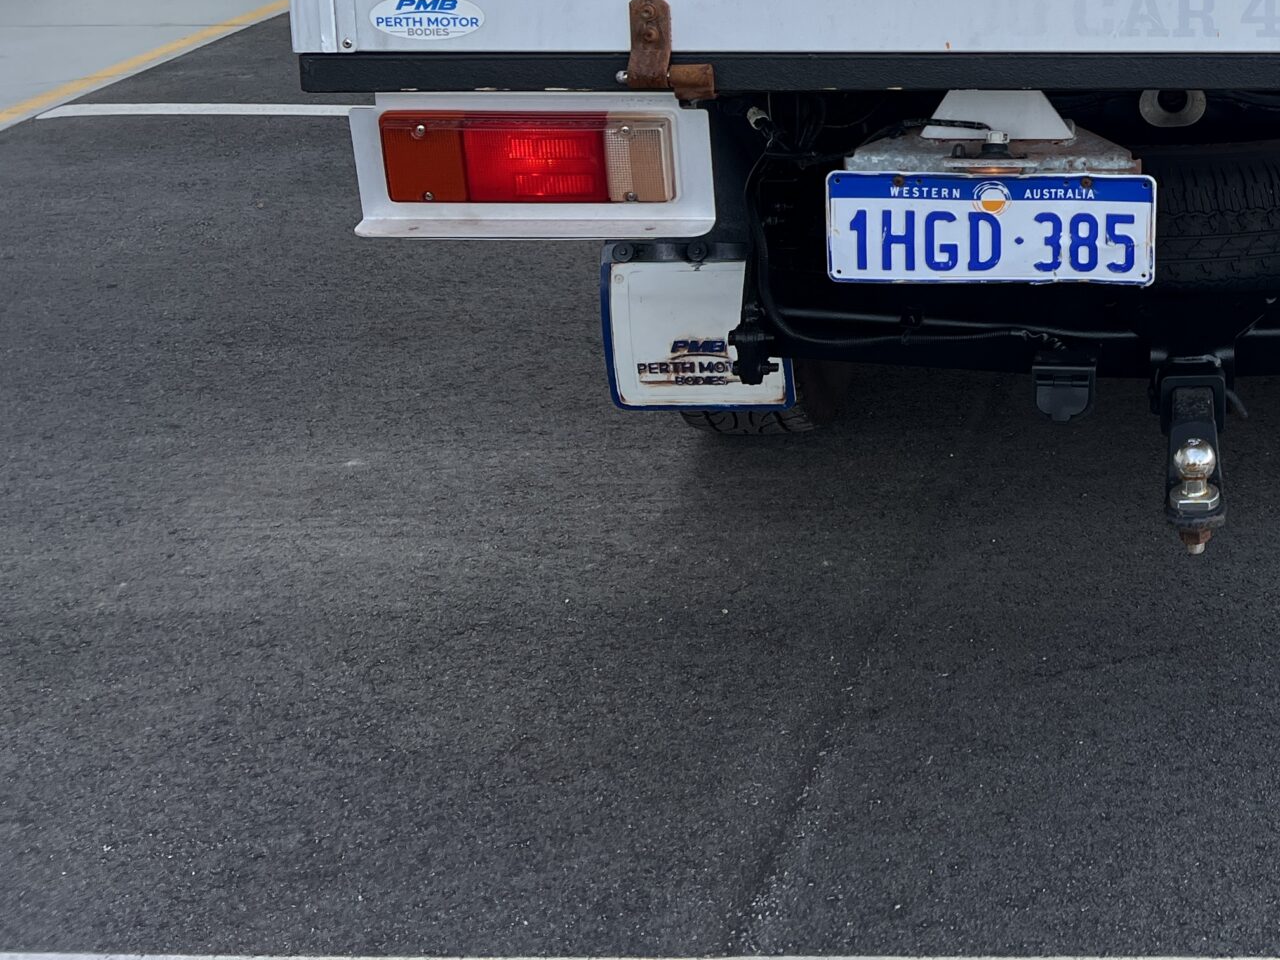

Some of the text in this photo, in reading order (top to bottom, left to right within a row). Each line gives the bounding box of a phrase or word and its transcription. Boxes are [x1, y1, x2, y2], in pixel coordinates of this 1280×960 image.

[396, 0, 458, 11] PMB
[376, 17, 479, 27] PERTH MOTOR
[407, 28, 450, 36] BODIES
[890, 187, 1095, 200] WESTERN AUSTRALIA
[670, 340, 727, 353] PMB
[637, 362, 696, 374] PERTH
[675, 376, 728, 385] BODIES
